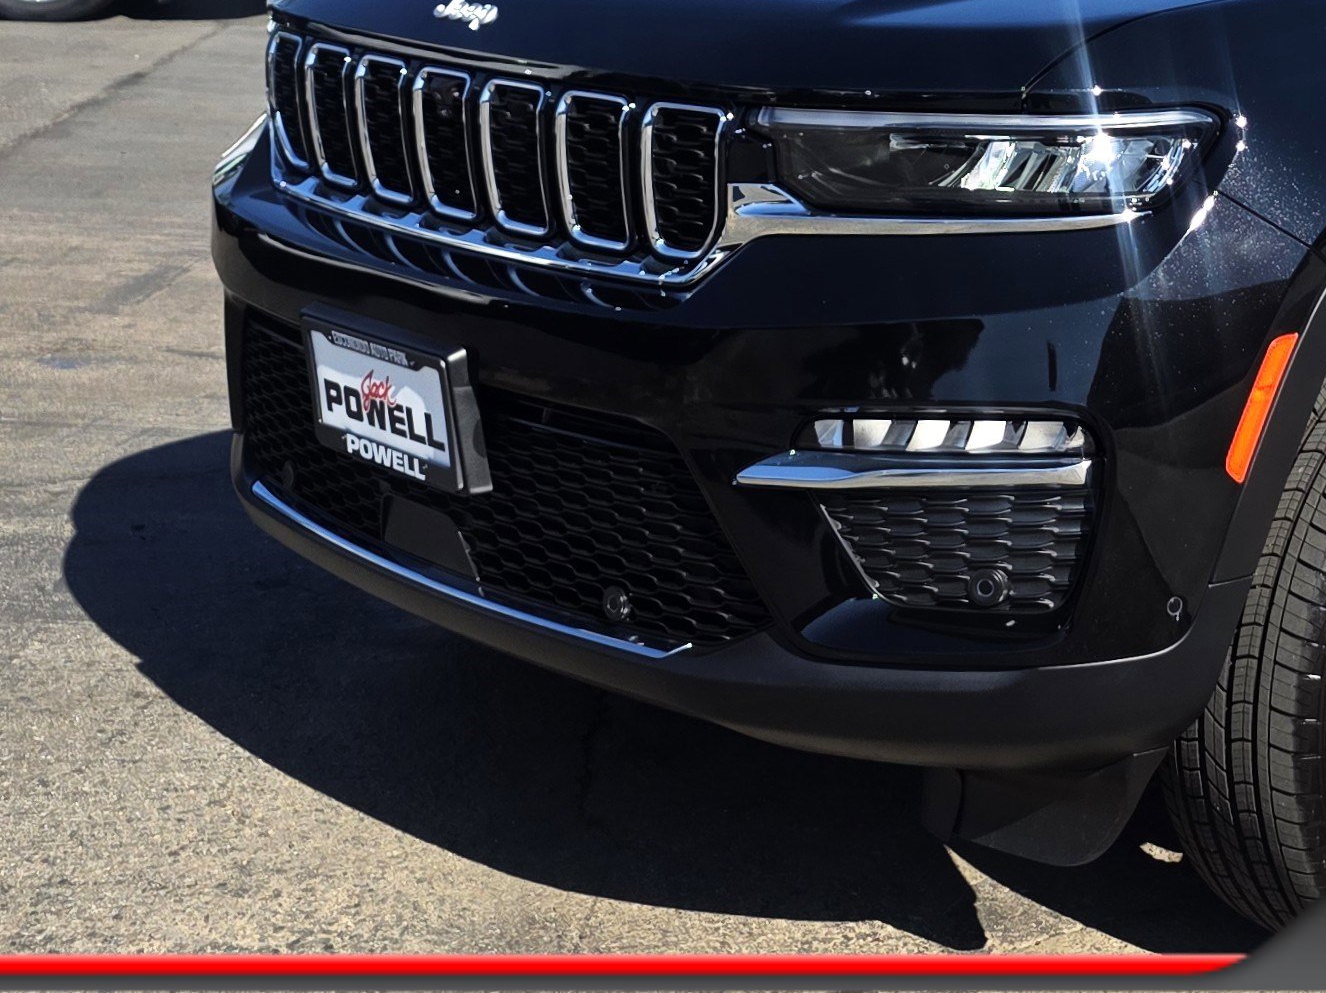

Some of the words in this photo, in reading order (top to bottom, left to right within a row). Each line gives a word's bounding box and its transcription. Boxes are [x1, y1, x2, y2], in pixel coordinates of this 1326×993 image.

[323, 378, 446, 453] POWELL
[360, 369, 397, 412] Jack
[345, 432, 427, 482] POWELL
